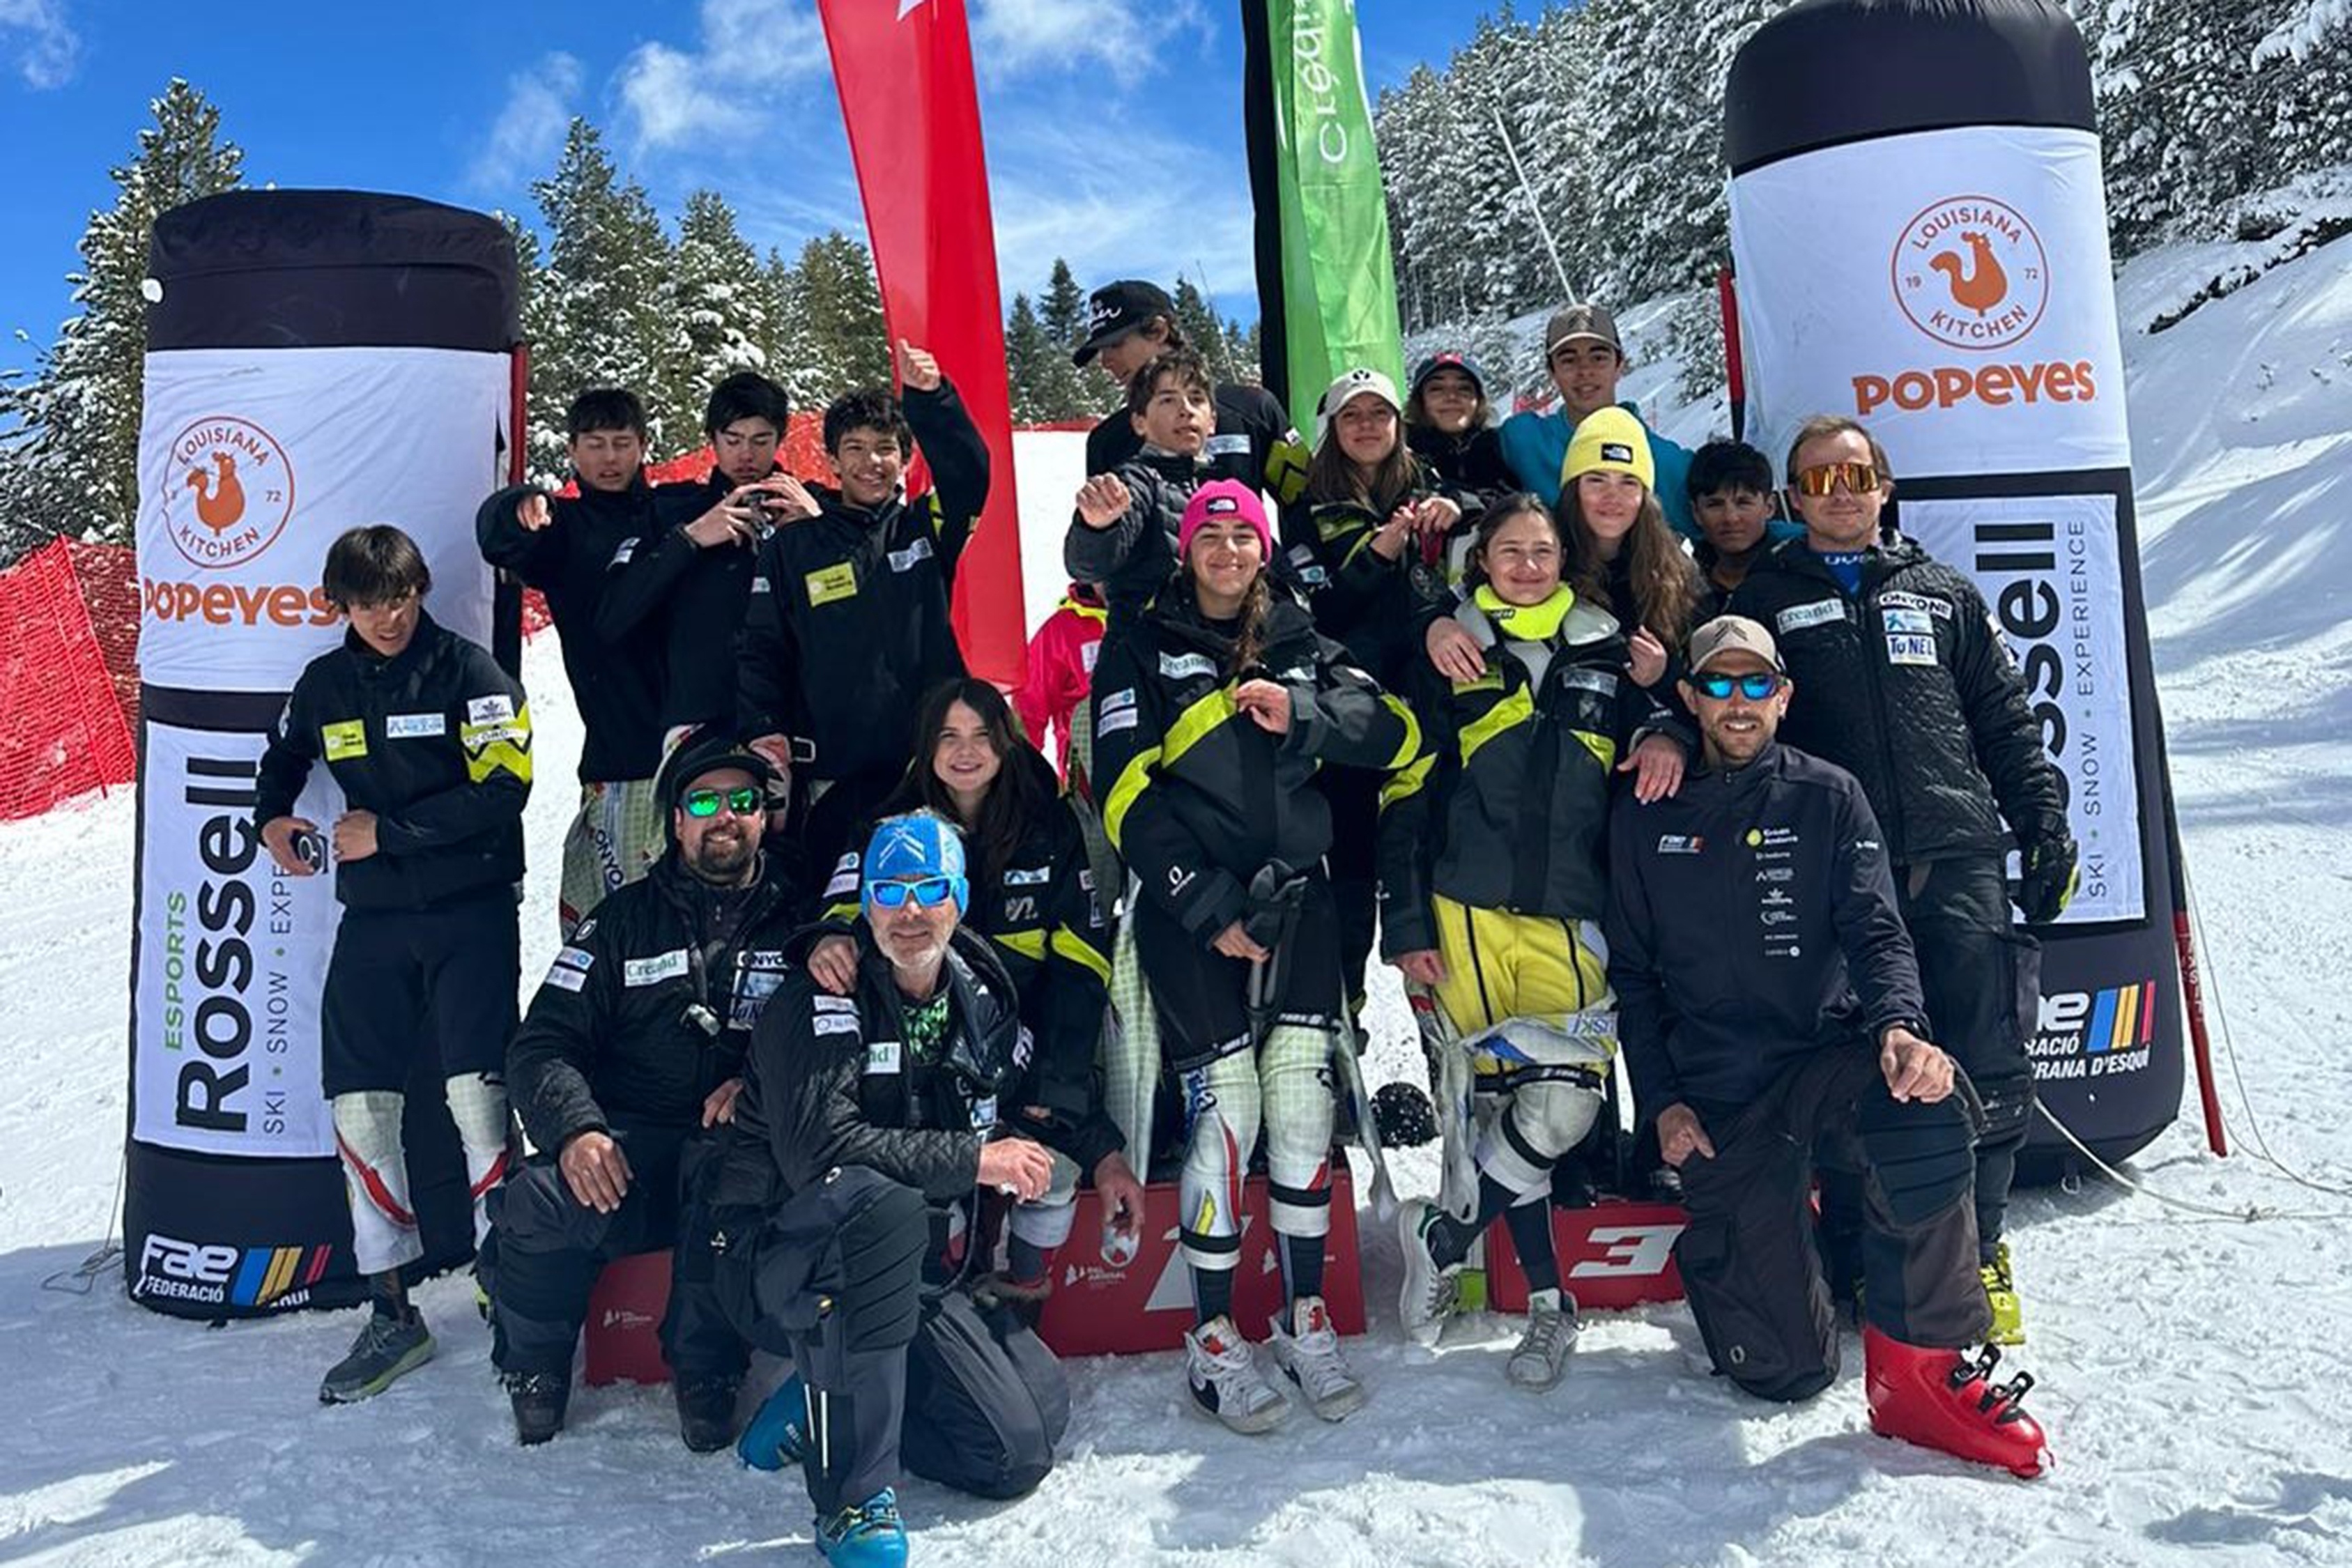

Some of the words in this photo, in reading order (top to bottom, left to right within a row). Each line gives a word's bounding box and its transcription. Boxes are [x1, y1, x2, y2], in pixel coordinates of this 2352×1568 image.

[1912, 208, 2021, 249] LOUISIANA
[1906, 276, 1921, 288] 19
[2024, 268, 2038, 279] 72
[1930, 305, 2027, 339] KITCHEN
[177, 427, 269, 466] LOUISIANA
[266, 490, 282, 502] 72
[179, 525, 261, 558] KITCHEN
[2067, 522, 2093, 697] EXPERIENCE
[1974, 522, 2070, 814] ssell
[2080, 732, 2101, 816] SNOW
[2088, 854, 2107, 898] SKI
[176, 757, 258, 1133] Rossell
[166, 891, 187, 1051] ESPORTS
[266, 971, 289, 1054] SNOW
[2031, 1059, 2086, 1080] RANA
[263, 1091, 285, 1135] SKI
[1569, 1224, 1686, 1279] 3
[146, 1275, 224, 1303] FEDERACIÓ
